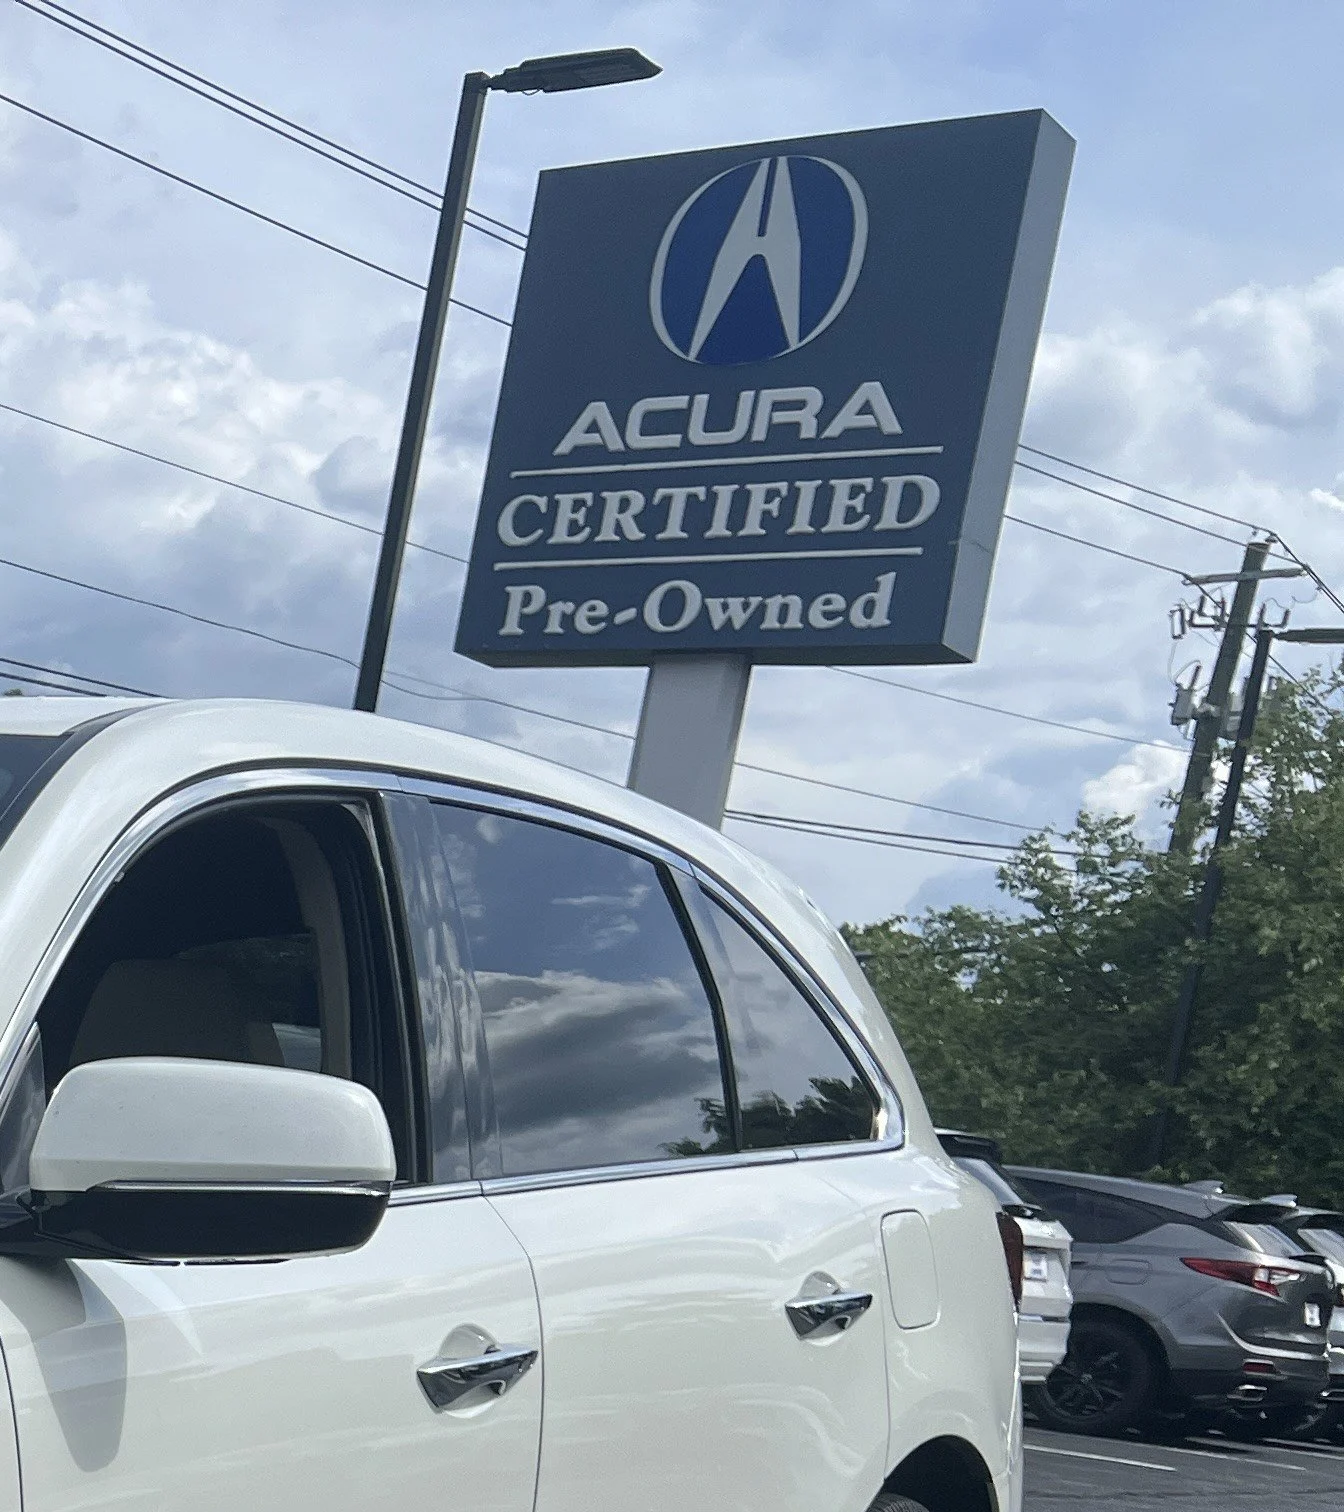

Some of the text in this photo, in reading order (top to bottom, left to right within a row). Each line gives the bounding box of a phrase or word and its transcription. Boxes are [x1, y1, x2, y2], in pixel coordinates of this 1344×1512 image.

[552, 381, 903, 456] ACURA
[496, 474, 941, 549] CERTIFIED
[497, 571, 899, 637] Pre-Owned
